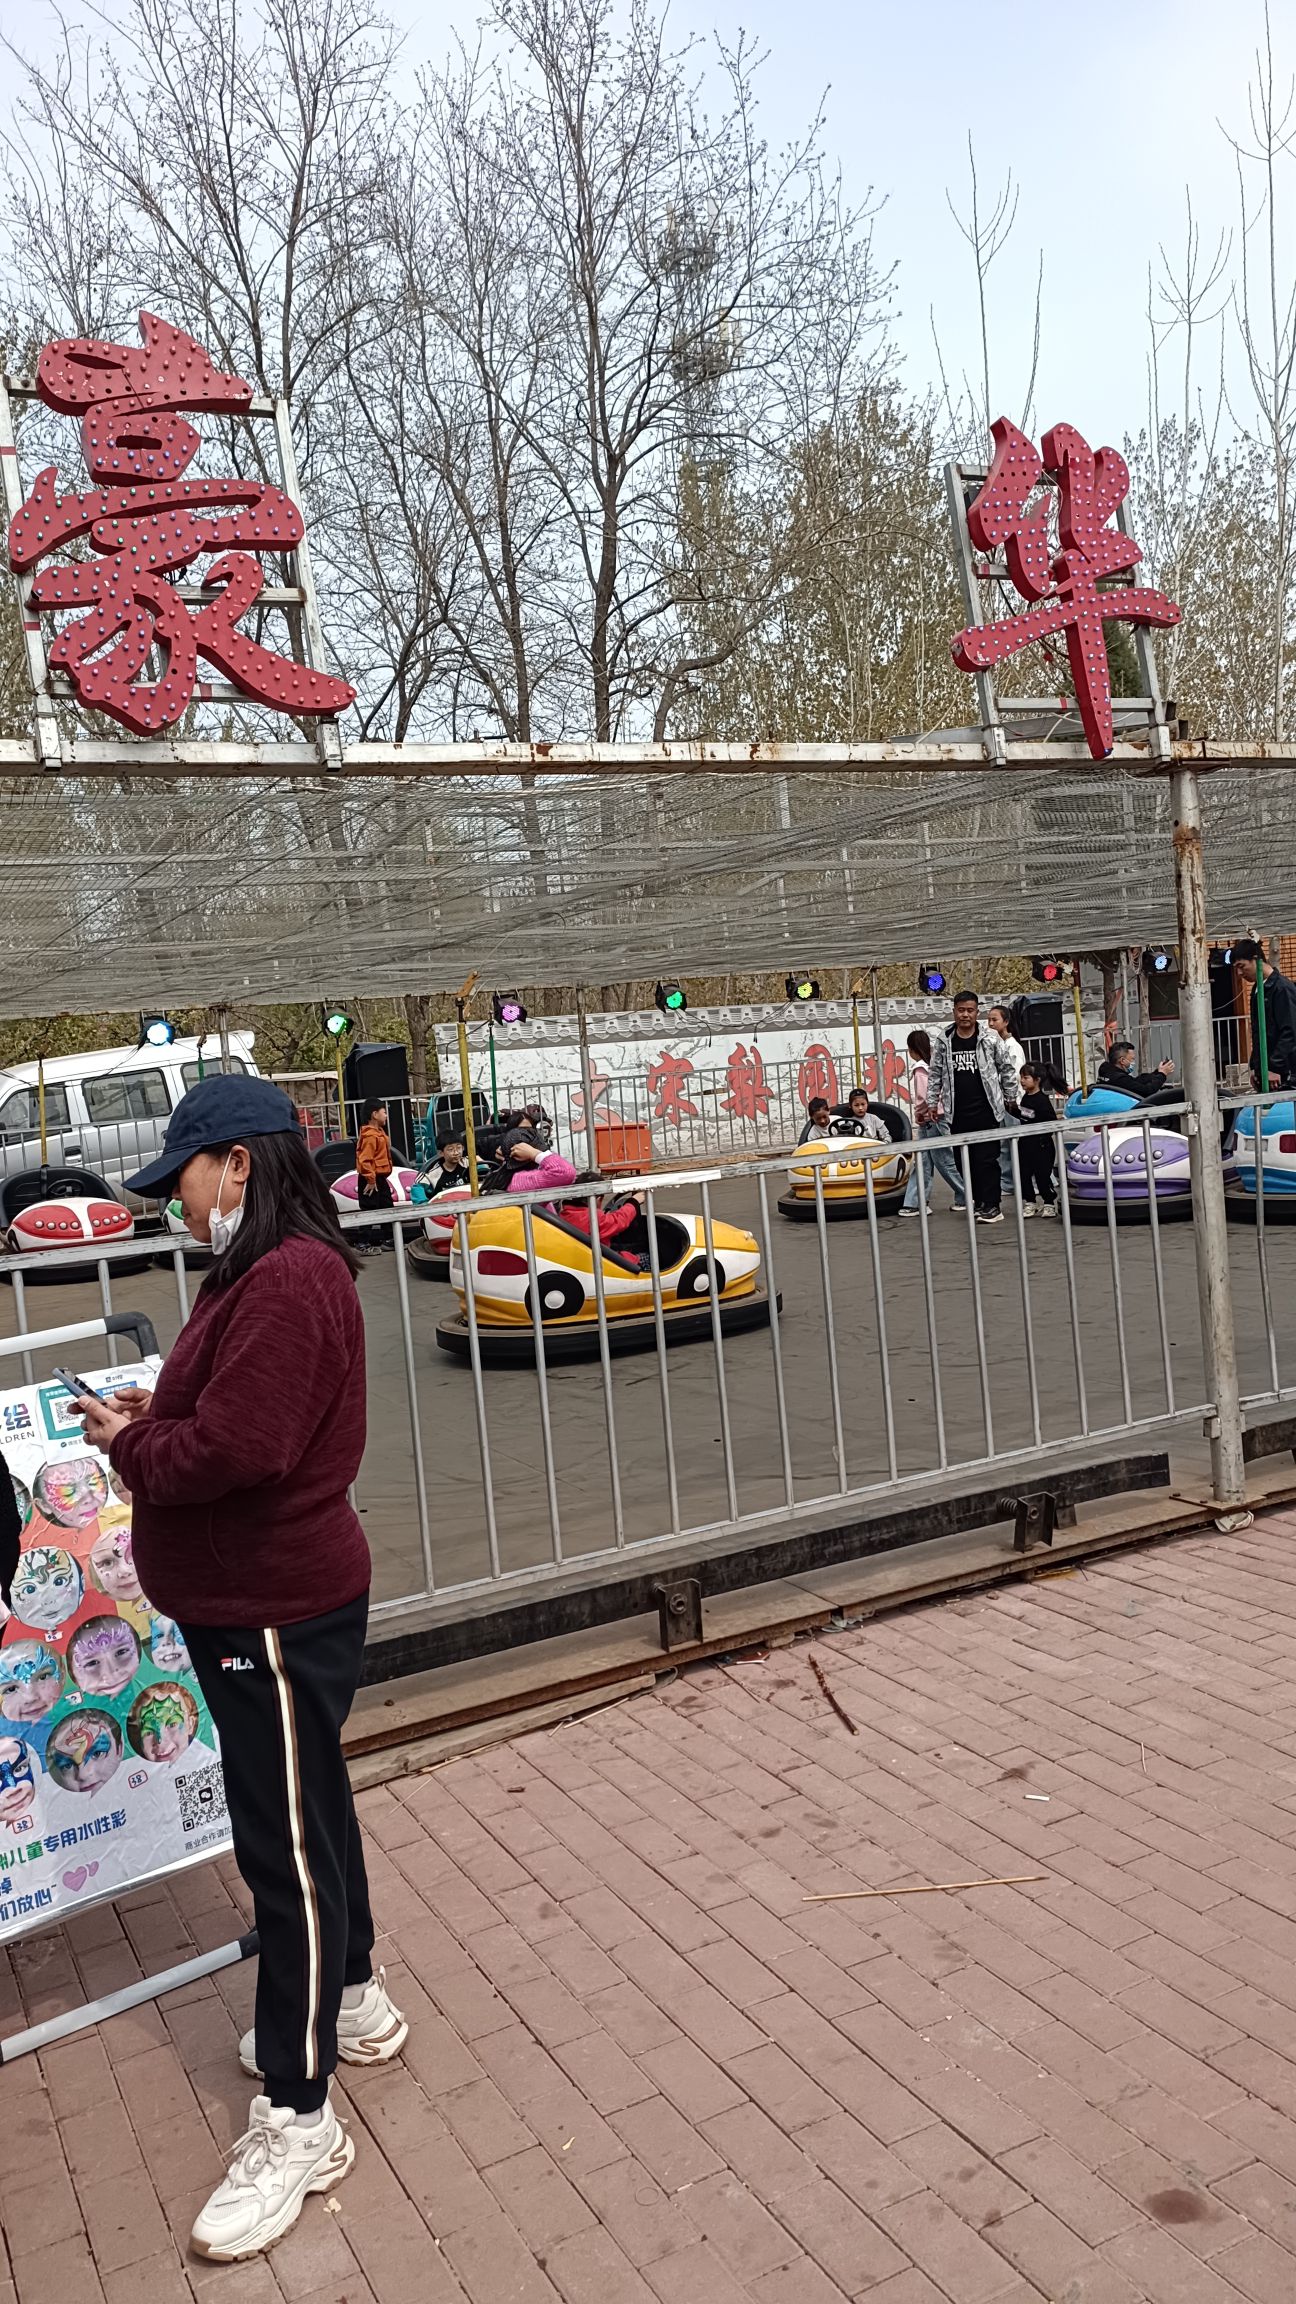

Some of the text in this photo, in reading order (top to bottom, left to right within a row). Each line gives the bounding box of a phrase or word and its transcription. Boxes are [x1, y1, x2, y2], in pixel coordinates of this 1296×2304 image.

[8, 310, 1182, 761] 豪 华
[220, 1656, 255, 1671] FILA
